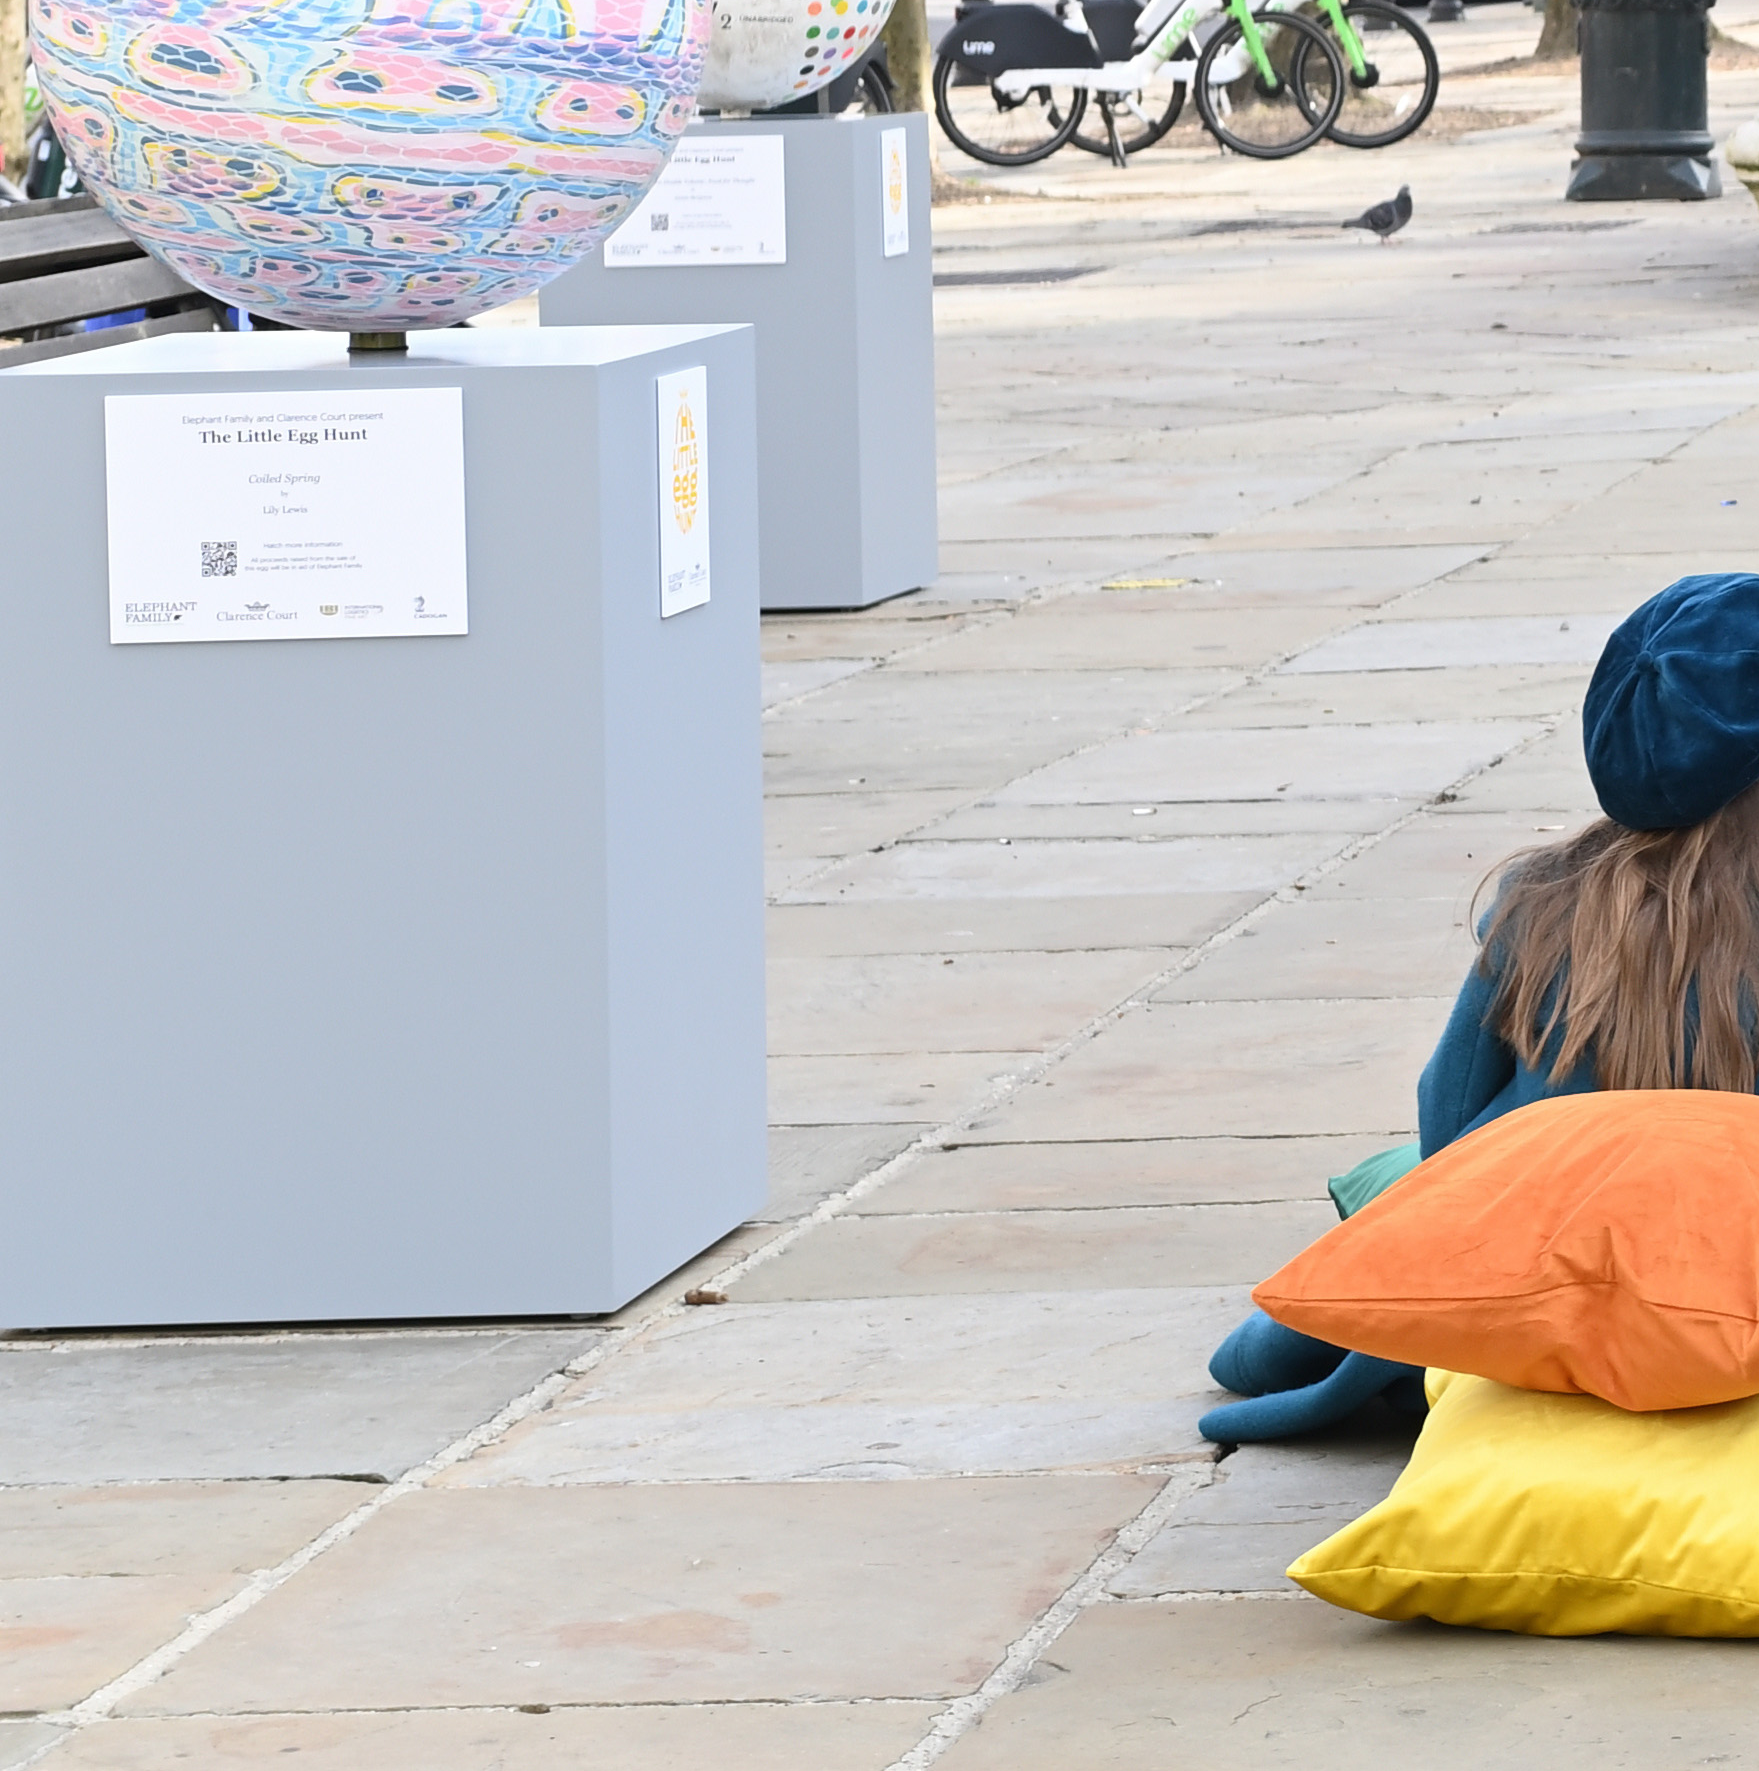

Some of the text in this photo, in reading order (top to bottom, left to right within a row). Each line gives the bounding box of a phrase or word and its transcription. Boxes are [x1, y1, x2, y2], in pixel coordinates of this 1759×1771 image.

[182, 411, 384, 425] Elephant Family and Clarence Court present
[198, 427, 368, 445] The Little Egg Hunt
[248, 472, 321, 485] Coiled Spring
[673, 468, 698, 509] egg
[263, 504, 308, 515] Lily Lewis
[125, 601, 197, 613] ELEPHANT
[125, 612, 173, 623] FAMILY
[216, 609, 298, 622] Clarence Court
